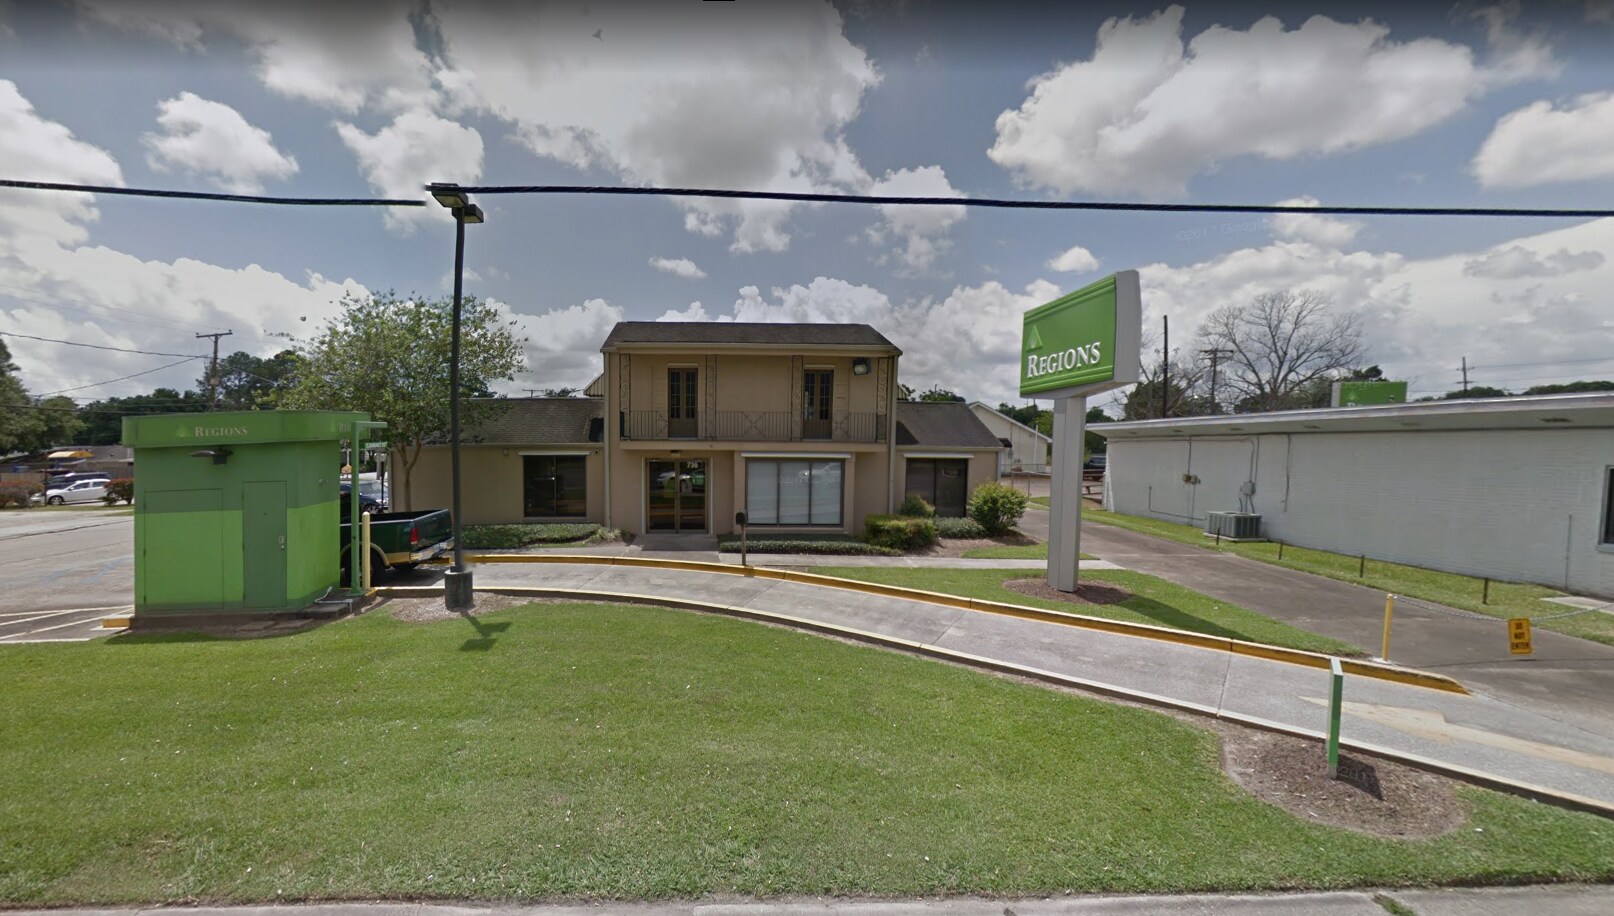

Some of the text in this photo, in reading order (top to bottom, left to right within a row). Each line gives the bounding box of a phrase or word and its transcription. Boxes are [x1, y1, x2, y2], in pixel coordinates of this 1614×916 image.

[1027, 341, 1101, 378] REGIONS
[194, 426, 248, 437] REGIONS
[1513, 632, 1525, 640] NOT
[1511, 642, 1530, 650] ENTER
